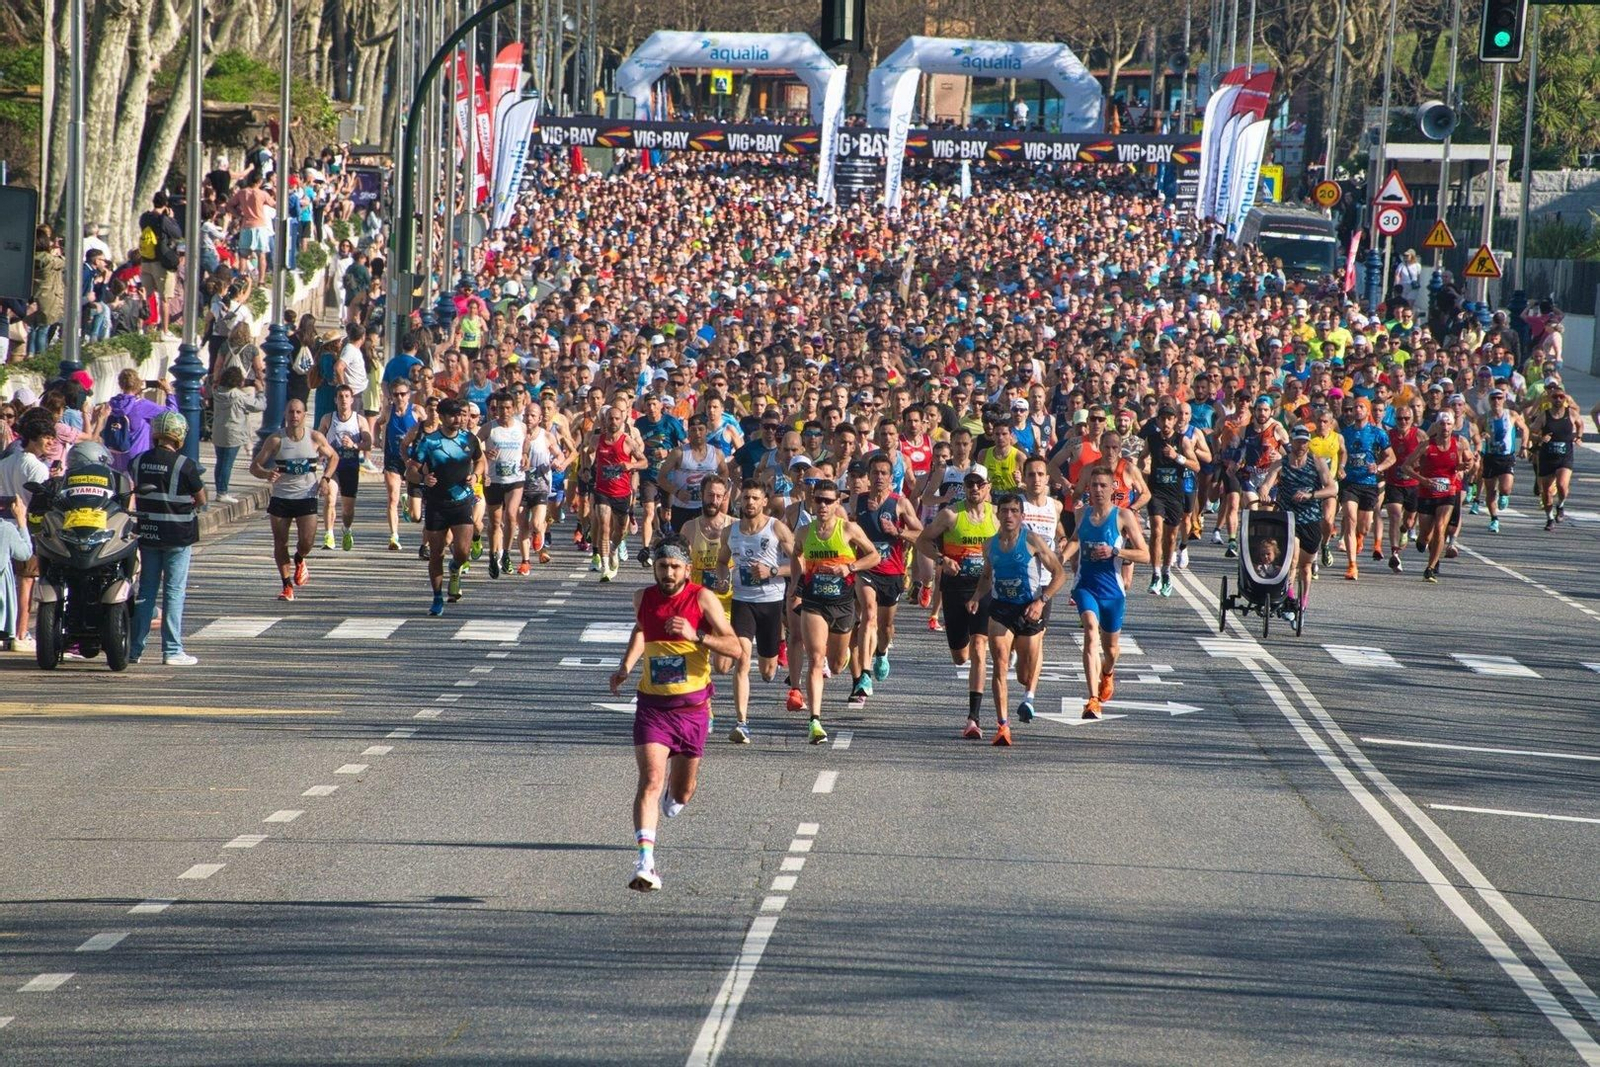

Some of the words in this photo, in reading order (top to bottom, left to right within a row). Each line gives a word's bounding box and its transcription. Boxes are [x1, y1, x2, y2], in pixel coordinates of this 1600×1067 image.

[710, 45, 770, 63] aqualia
[962, 54, 1021, 72] aqualia
[1319, 189, 1335, 199] 20
[1383, 215, 1400, 226] 30
[140, 524, 158, 532] MOTO
[962, 536, 987, 545] 3NORT
[809, 550, 839, 559] 3NORTH
[817, 584, 839, 593] 3862
